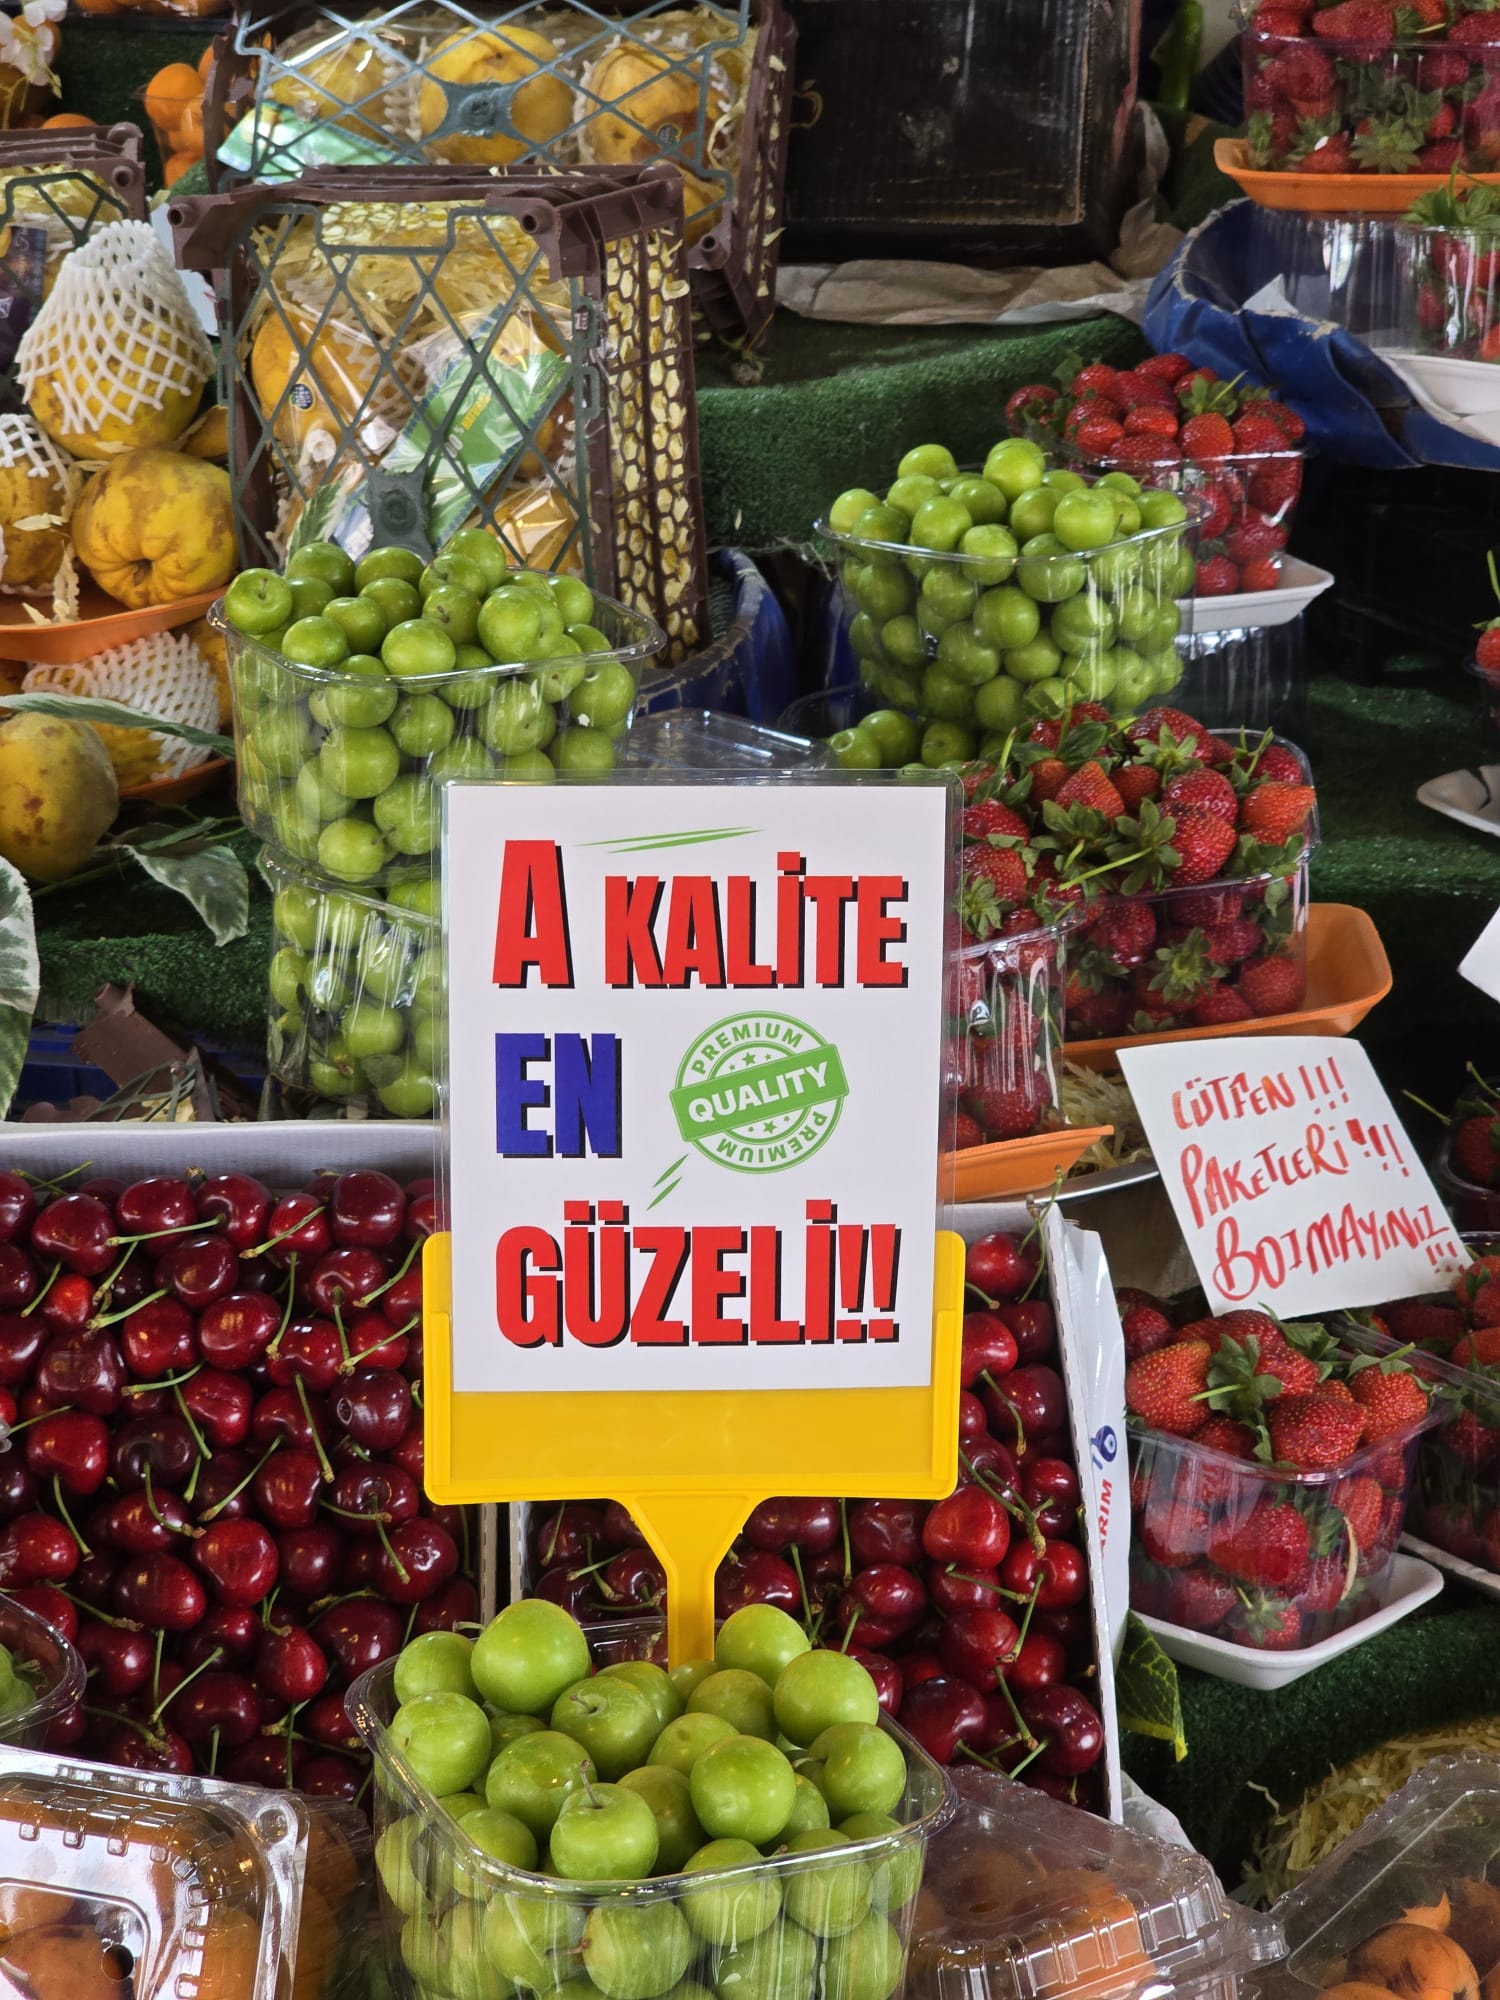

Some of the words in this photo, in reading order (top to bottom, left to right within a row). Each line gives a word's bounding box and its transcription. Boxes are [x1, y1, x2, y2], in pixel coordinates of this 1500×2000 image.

[492, 840, 575, 988] A
[605, 852, 909, 988] KALİTE
[688, 1061, 828, 1123] QUALITY
[691, 1022, 803, 1075] PREMIUM
[495, 1033, 622, 1158] EN
[716, 1111, 828, 1163] PREMIUM
[496, 1200, 902, 1348] GÜZELİ!!
